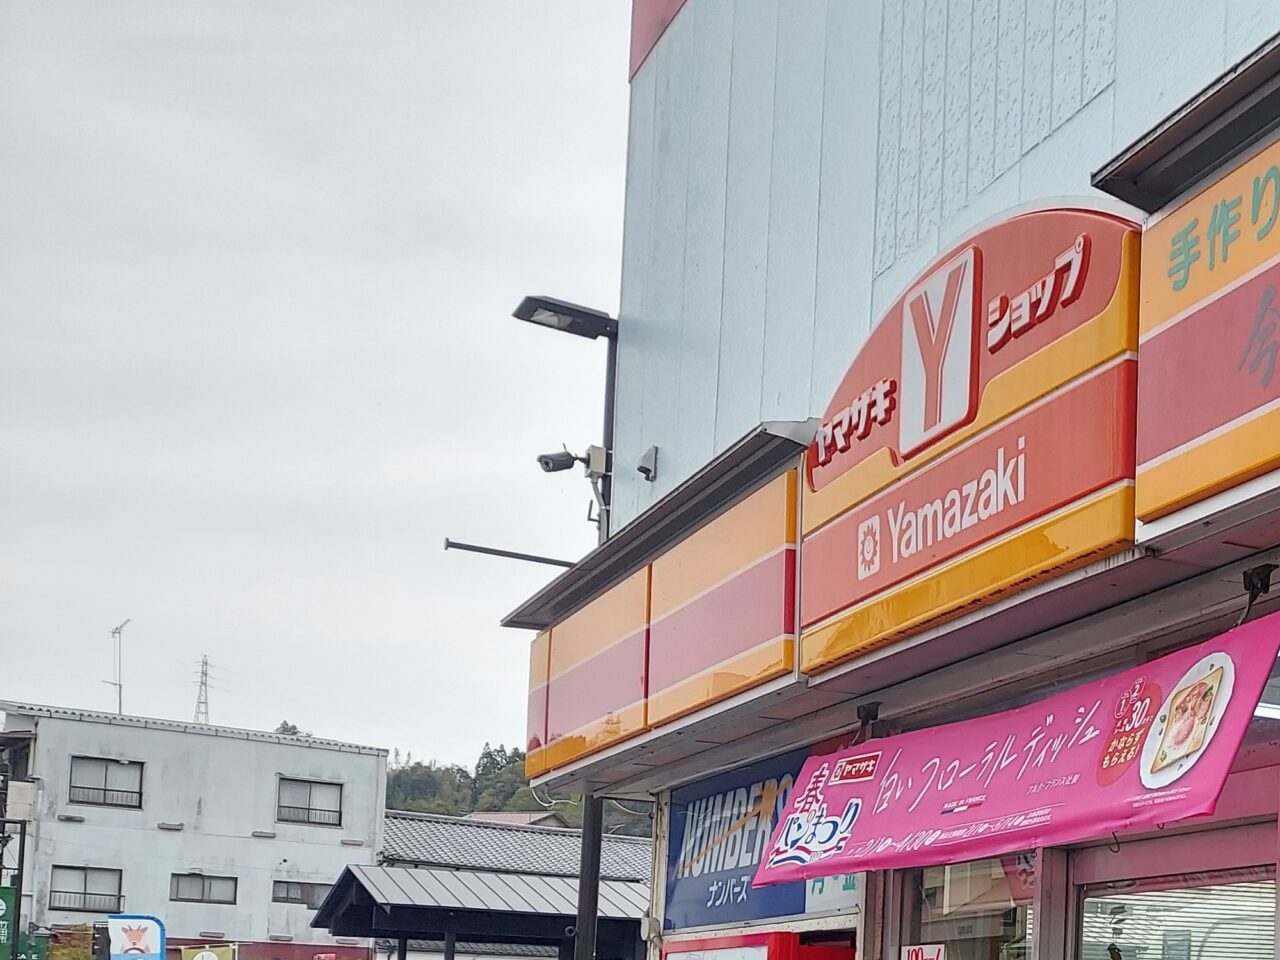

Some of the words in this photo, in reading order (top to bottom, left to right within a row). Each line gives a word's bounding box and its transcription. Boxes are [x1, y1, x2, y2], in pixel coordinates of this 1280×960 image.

[814, 378, 897, 466] ヤマザキ
[906, 258, 970, 434] Y
[987, 233, 1092, 355] ショップ
[887, 435, 1026, 565] Yamazaki
